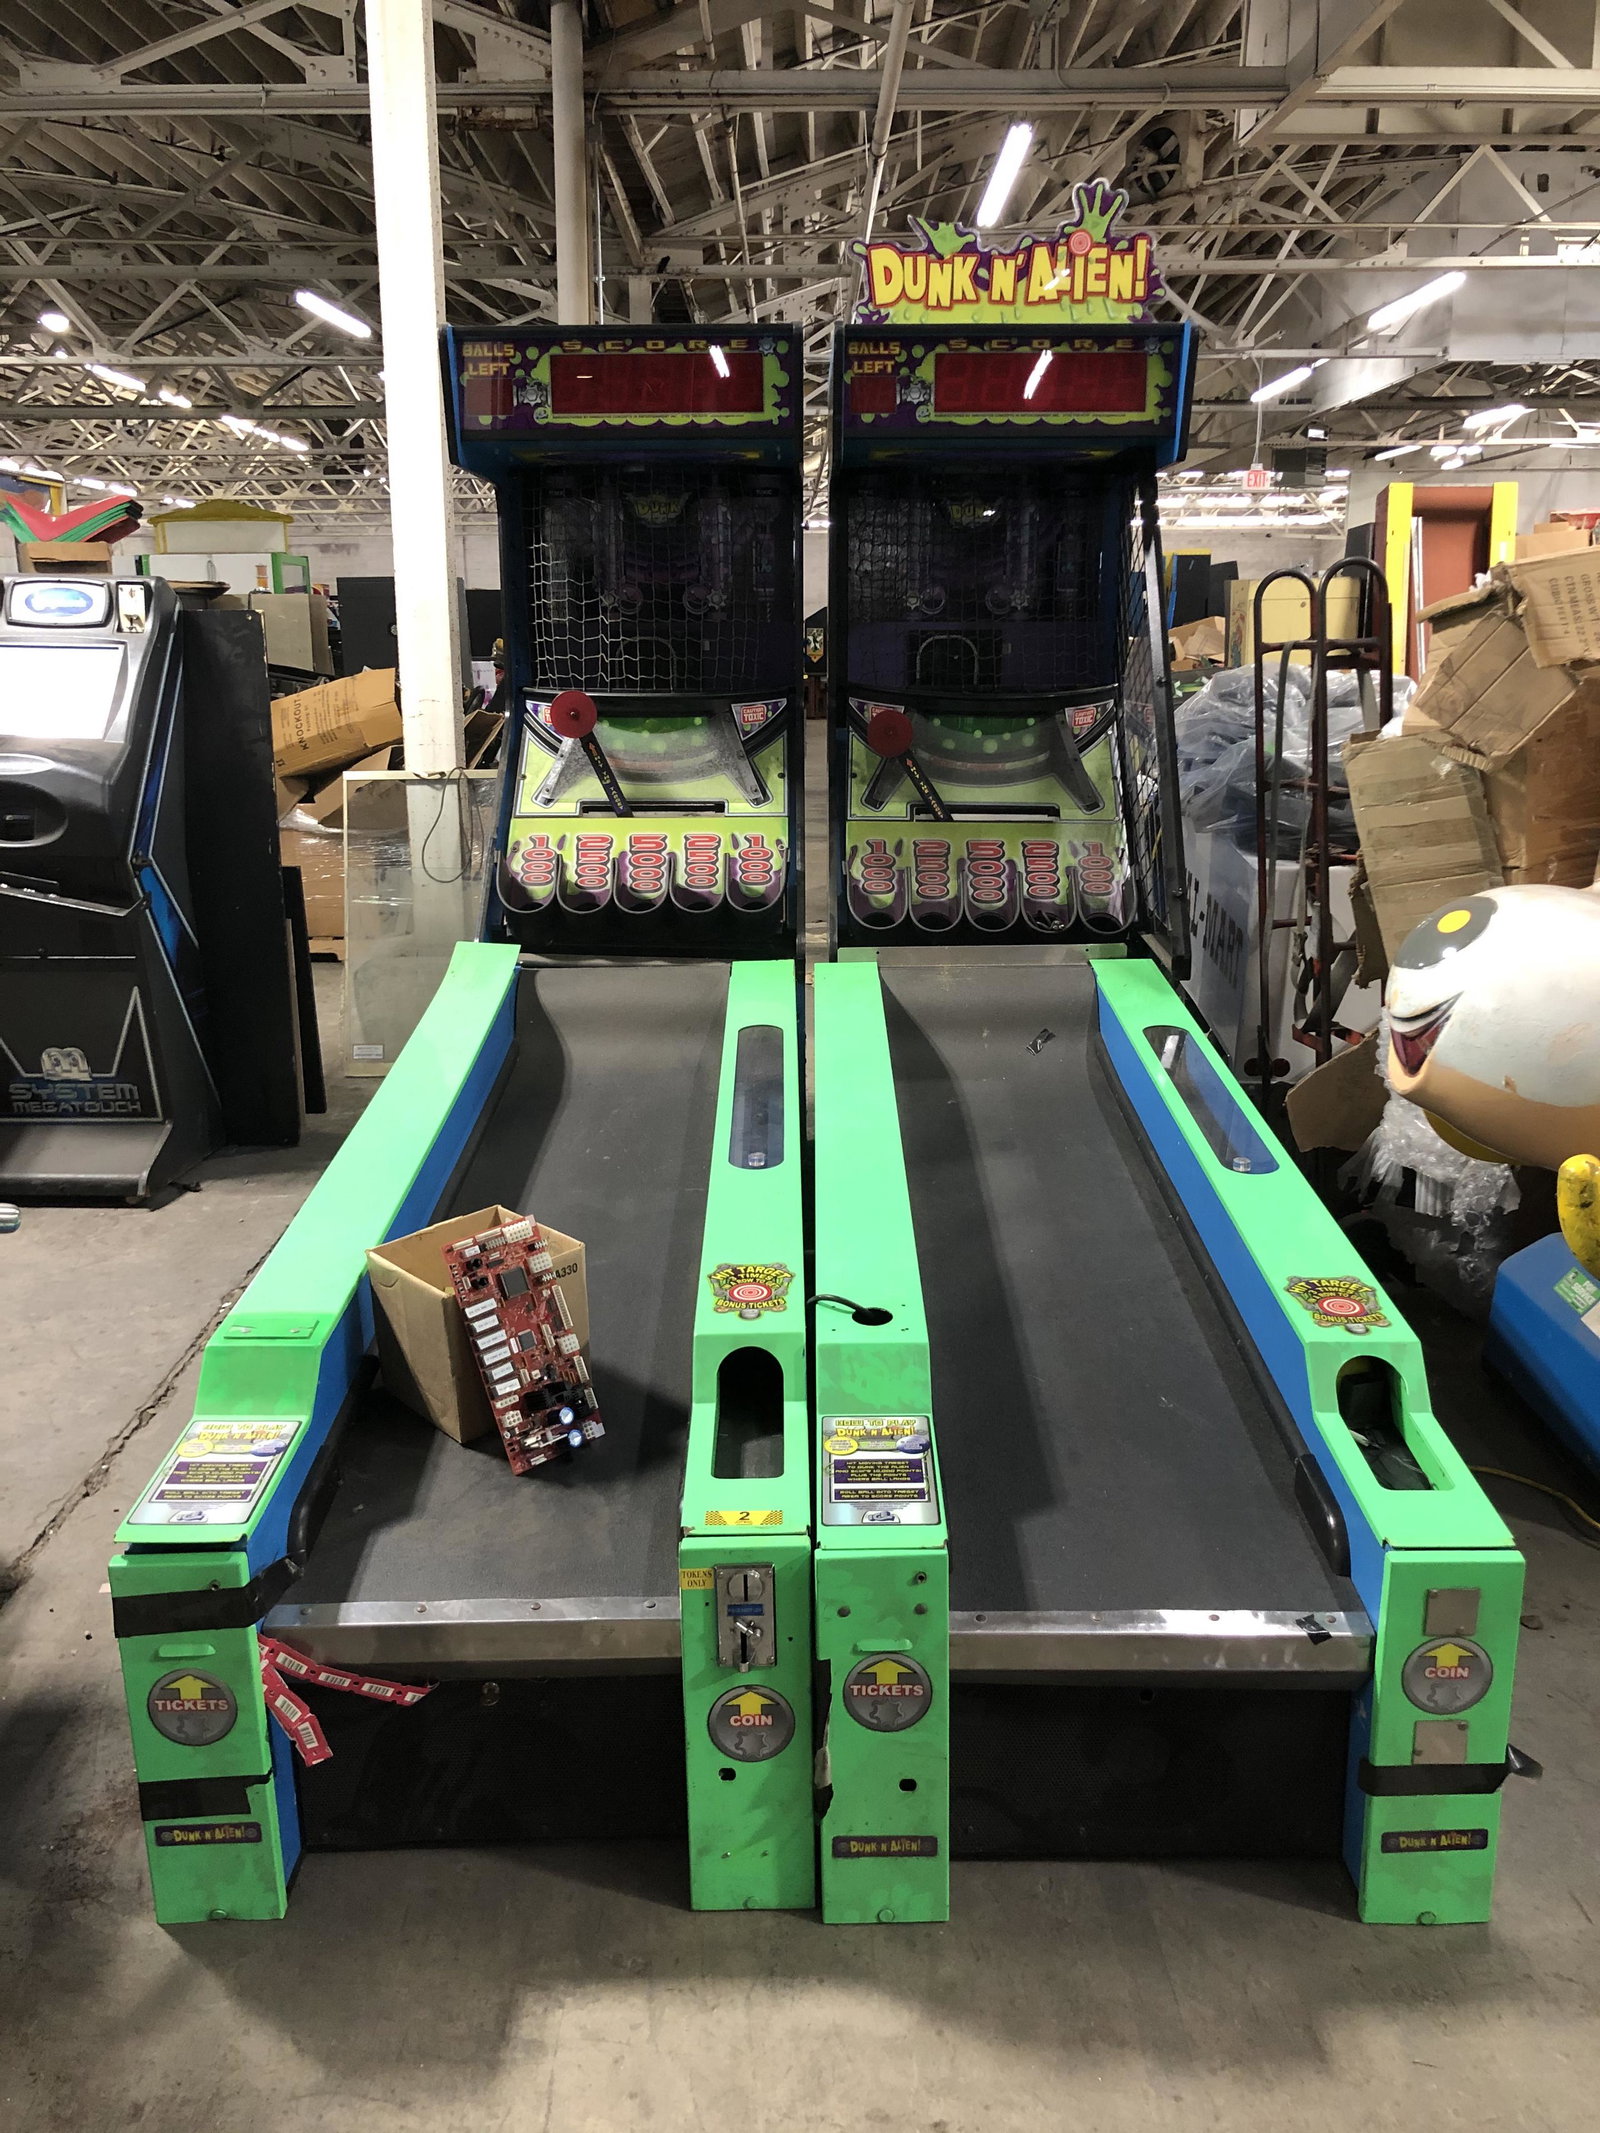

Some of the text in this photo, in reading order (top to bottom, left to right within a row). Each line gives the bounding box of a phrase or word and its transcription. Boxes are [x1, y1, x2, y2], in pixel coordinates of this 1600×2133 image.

[869, 245, 978, 308] DUNK
[1027, 237, 1149, 305] ALIEN!
[562, 340, 749, 350] SCORE
[848, 341, 901, 355] BALLS
[949, 338, 1134, 349] SCORE
[463, 344, 514, 357] BALLS
[467, 363, 510, 376] LEFT
[852, 360, 895, 374] LEFT
[1247, 472, 1267, 488] EXIT
[1581, 573, 1596, 605] GROSS
[293, 697, 309, 750] KNOCKOUT
[743, 713, 764, 722] TOXIC
[9, 1083, 140, 1101] SYSTEM
[13, 1101, 142, 1113] MEGATOUCH
[711, 1266, 792, 1280] HIT TARGET
[738, 1273, 773, 1281] TIMES
[1289, 1279, 1372, 1294] HIT TARGET
[1318, 1286, 1356, 1295] TIMES
[717, 1299, 785, 1309] BONUS TICKETS
[1313, 1313, 1385, 1323] BONUS TICKETS
[836, 1428, 867, 1437] DUNK
[881, 1427, 915, 1437] ALIEN!
[739, 1511, 750, 1521] 2
[682, 1570, 713, 1579] TOKENS
[687, 1579, 707, 1587] ONLY
[1424, 1667, 1470, 1678] COIN
[851, 1684, 925, 1696] TICKETS
[154, 1699, 229, 1712] TICKETS
[729, 1714, 774, 1726] COIN
[173, 1829, 202, 1842] DUNK
[214, 1826, 246, 1840] ALIEN!
[1399, 1836, 1427, 1848] DUNK
[1440, 1832, 1472, 1847] ALIEN!
[849, 1840, 877, 1853] DUNK
[890, 1838, 921, 1852] ALIEN!
